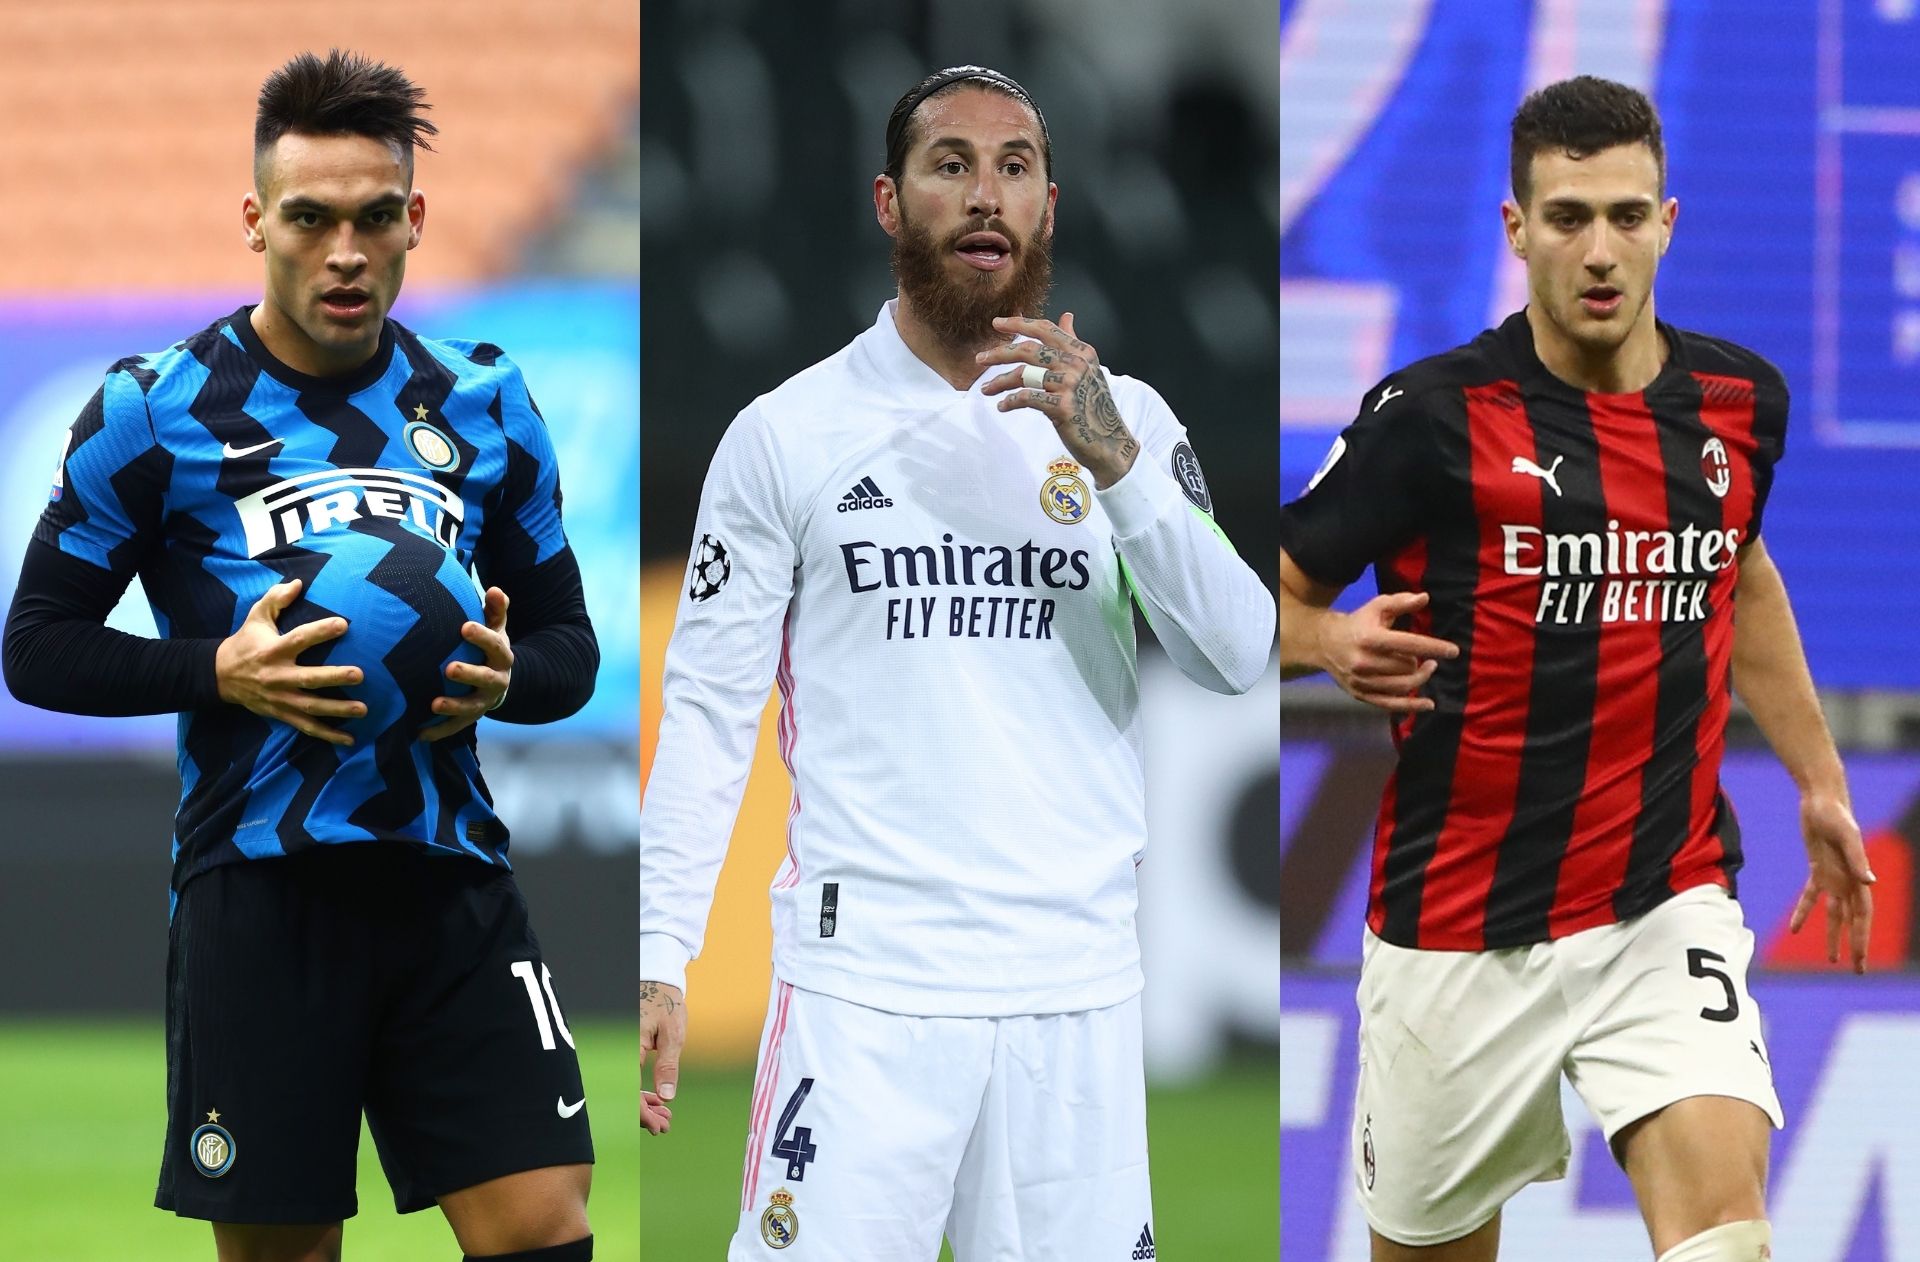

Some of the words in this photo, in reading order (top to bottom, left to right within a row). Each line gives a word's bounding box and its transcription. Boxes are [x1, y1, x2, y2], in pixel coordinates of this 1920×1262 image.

[837, 495, 893, 513] adidas
[839, 533, 1090, 593] Emirates
[1501, 520, 1739, 576] Emirates
[887, 597, 936, 640] FLY
[949, 597, 1056, 640] BETTER
[1535, 581, 1595, 624] FLY
[1602, 580, 1709, 623] BETTER
[1686, 948, 1739, 1022] 5
[771, 1078, 817, 1182] 4
[1132, 1245, 1155, 1260] adida
